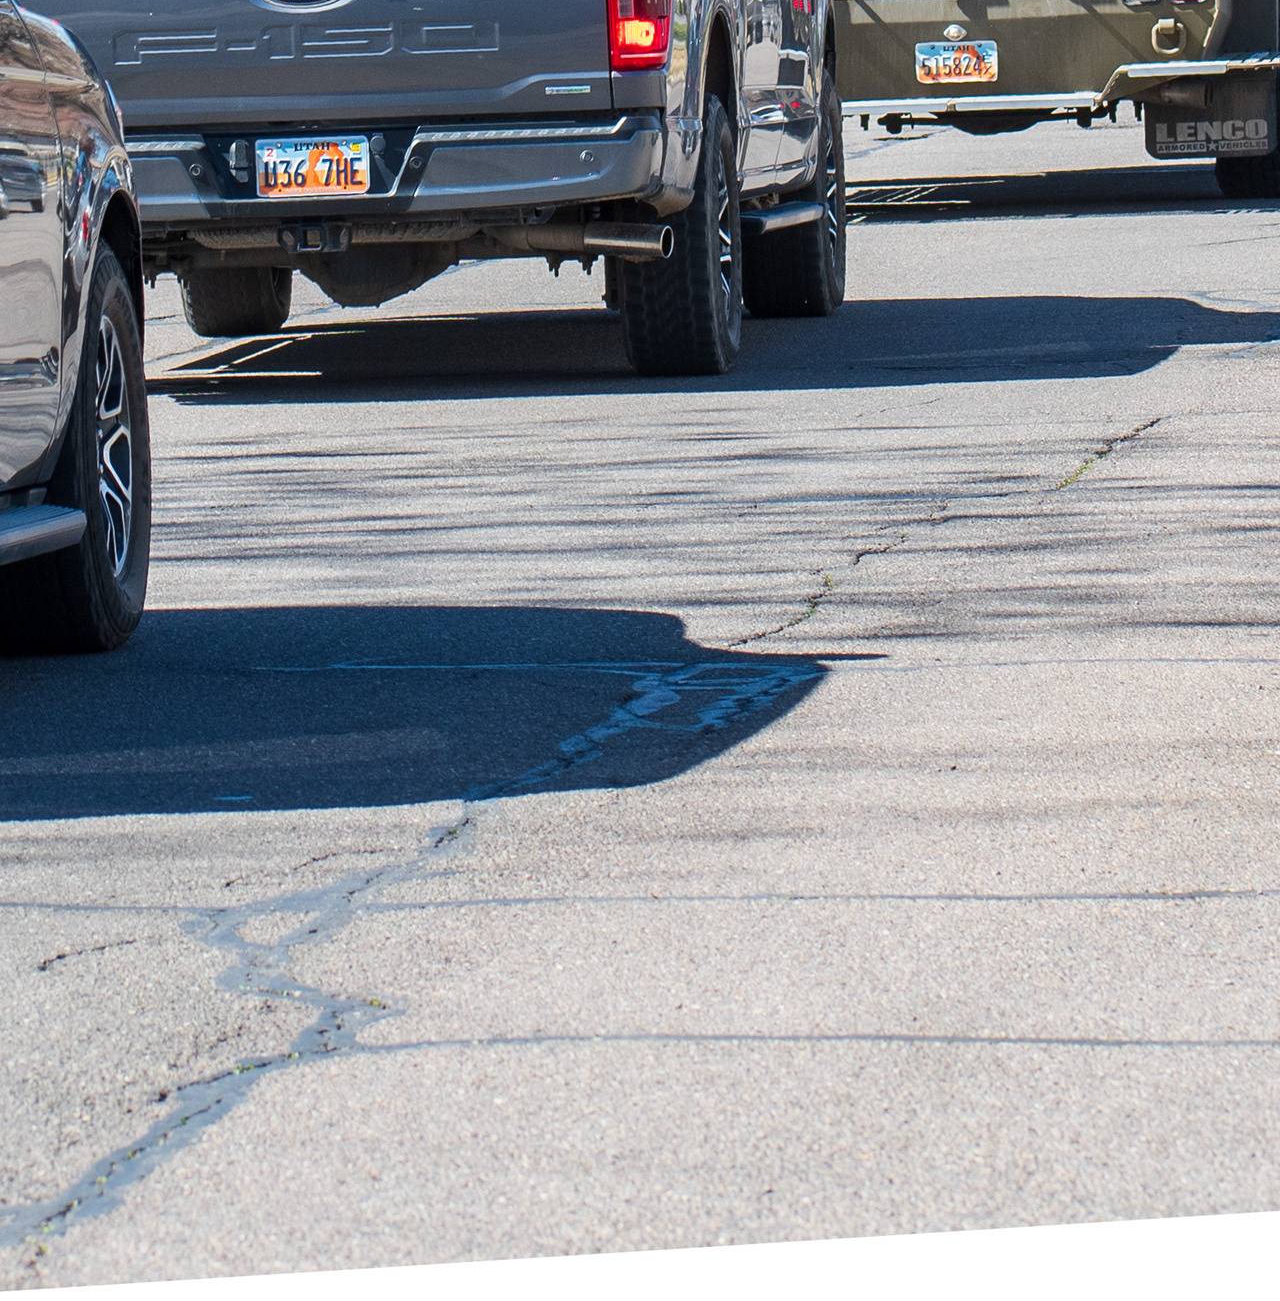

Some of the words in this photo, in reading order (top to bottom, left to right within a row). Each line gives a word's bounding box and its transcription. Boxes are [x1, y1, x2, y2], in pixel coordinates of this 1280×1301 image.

[113, 21, 500, 66] F-150
[922, 55, 981, 76] 515824
[1156, 118, 1268, 142] LENCO
[266, 148, 274, 158] 2
[293, 141, 332, 152] UTAH
[1158, 143, 1206, 152] ARMORED
[1219, 140, 1268, 150] VEHICLES
[264, 159, 306, 188] U36
[321, 157, 363, 187] 7HE
